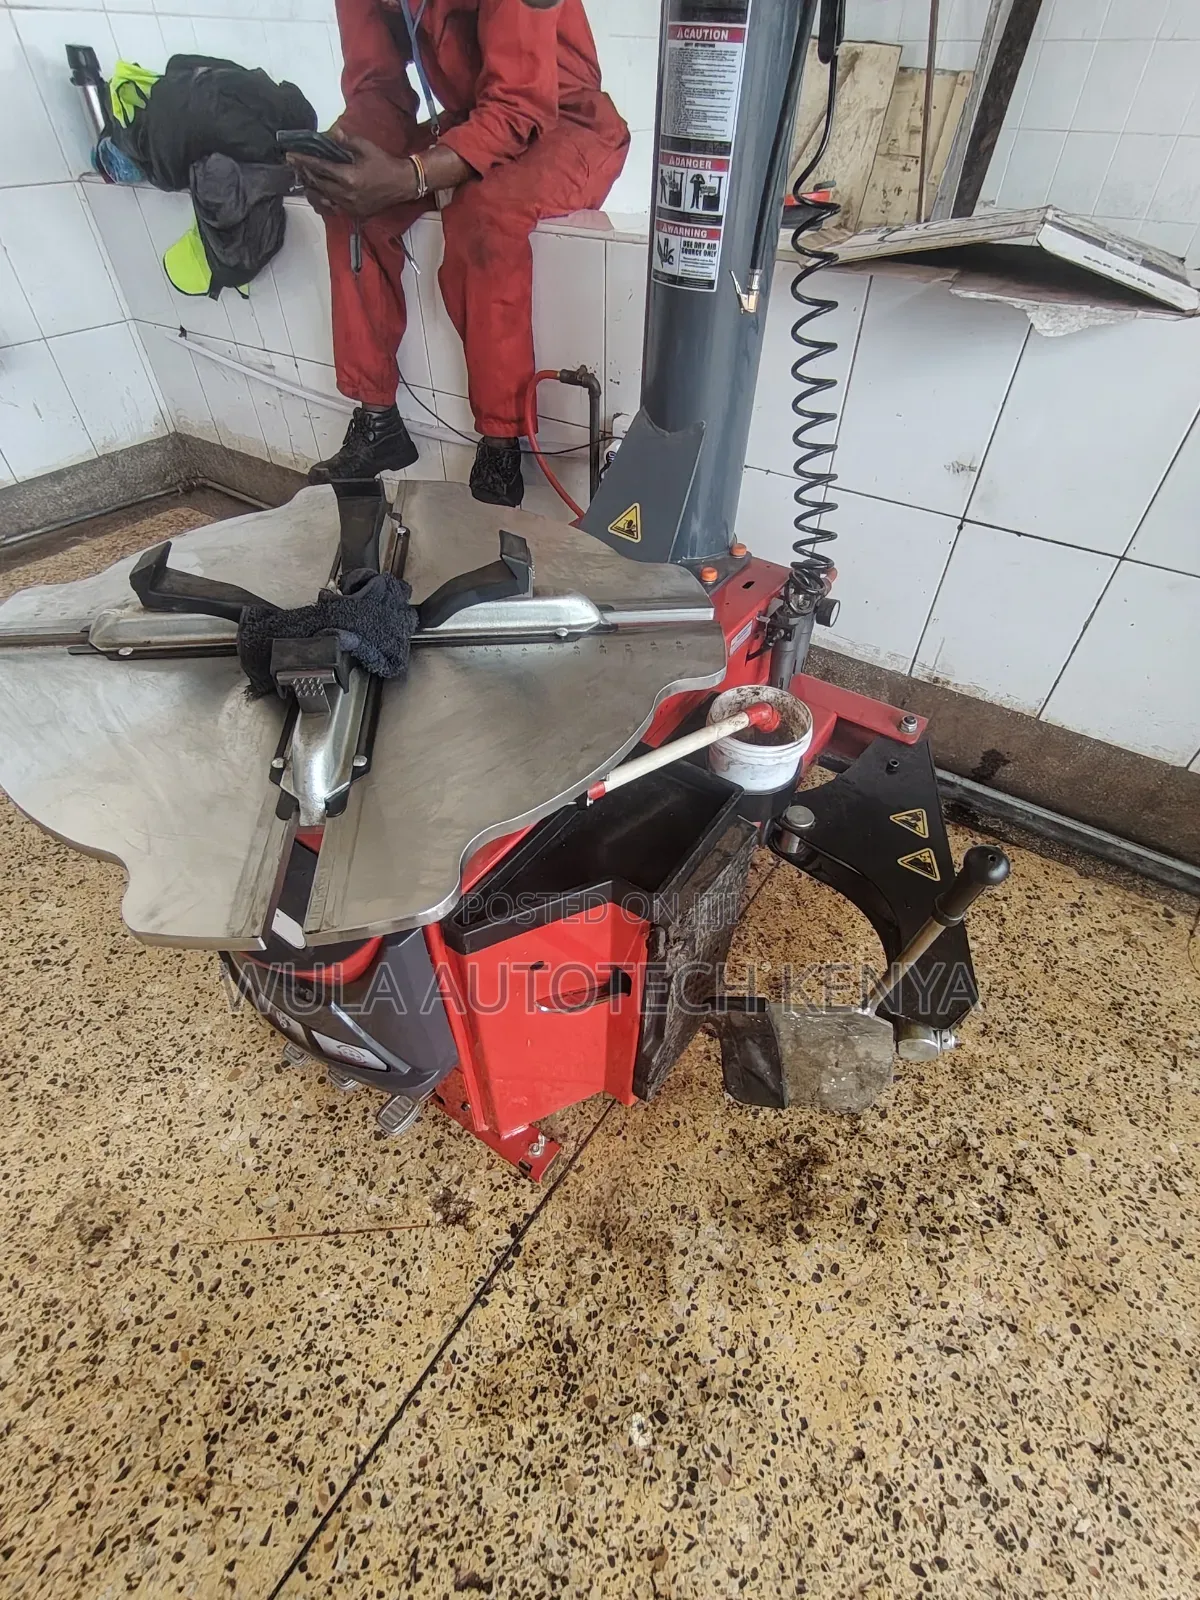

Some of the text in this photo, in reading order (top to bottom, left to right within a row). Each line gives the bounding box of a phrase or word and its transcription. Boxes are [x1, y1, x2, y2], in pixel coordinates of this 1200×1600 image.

[683, 27, 729, 41] CAUTION
[675, 156, 712, 170] DANGER
[667, 224, 708, 238] WARNING
[681, 248, 717, 257] SOURCE ONLY
[682, 241, 693, 249] USE
[694, 241, 706, 250] DRY
